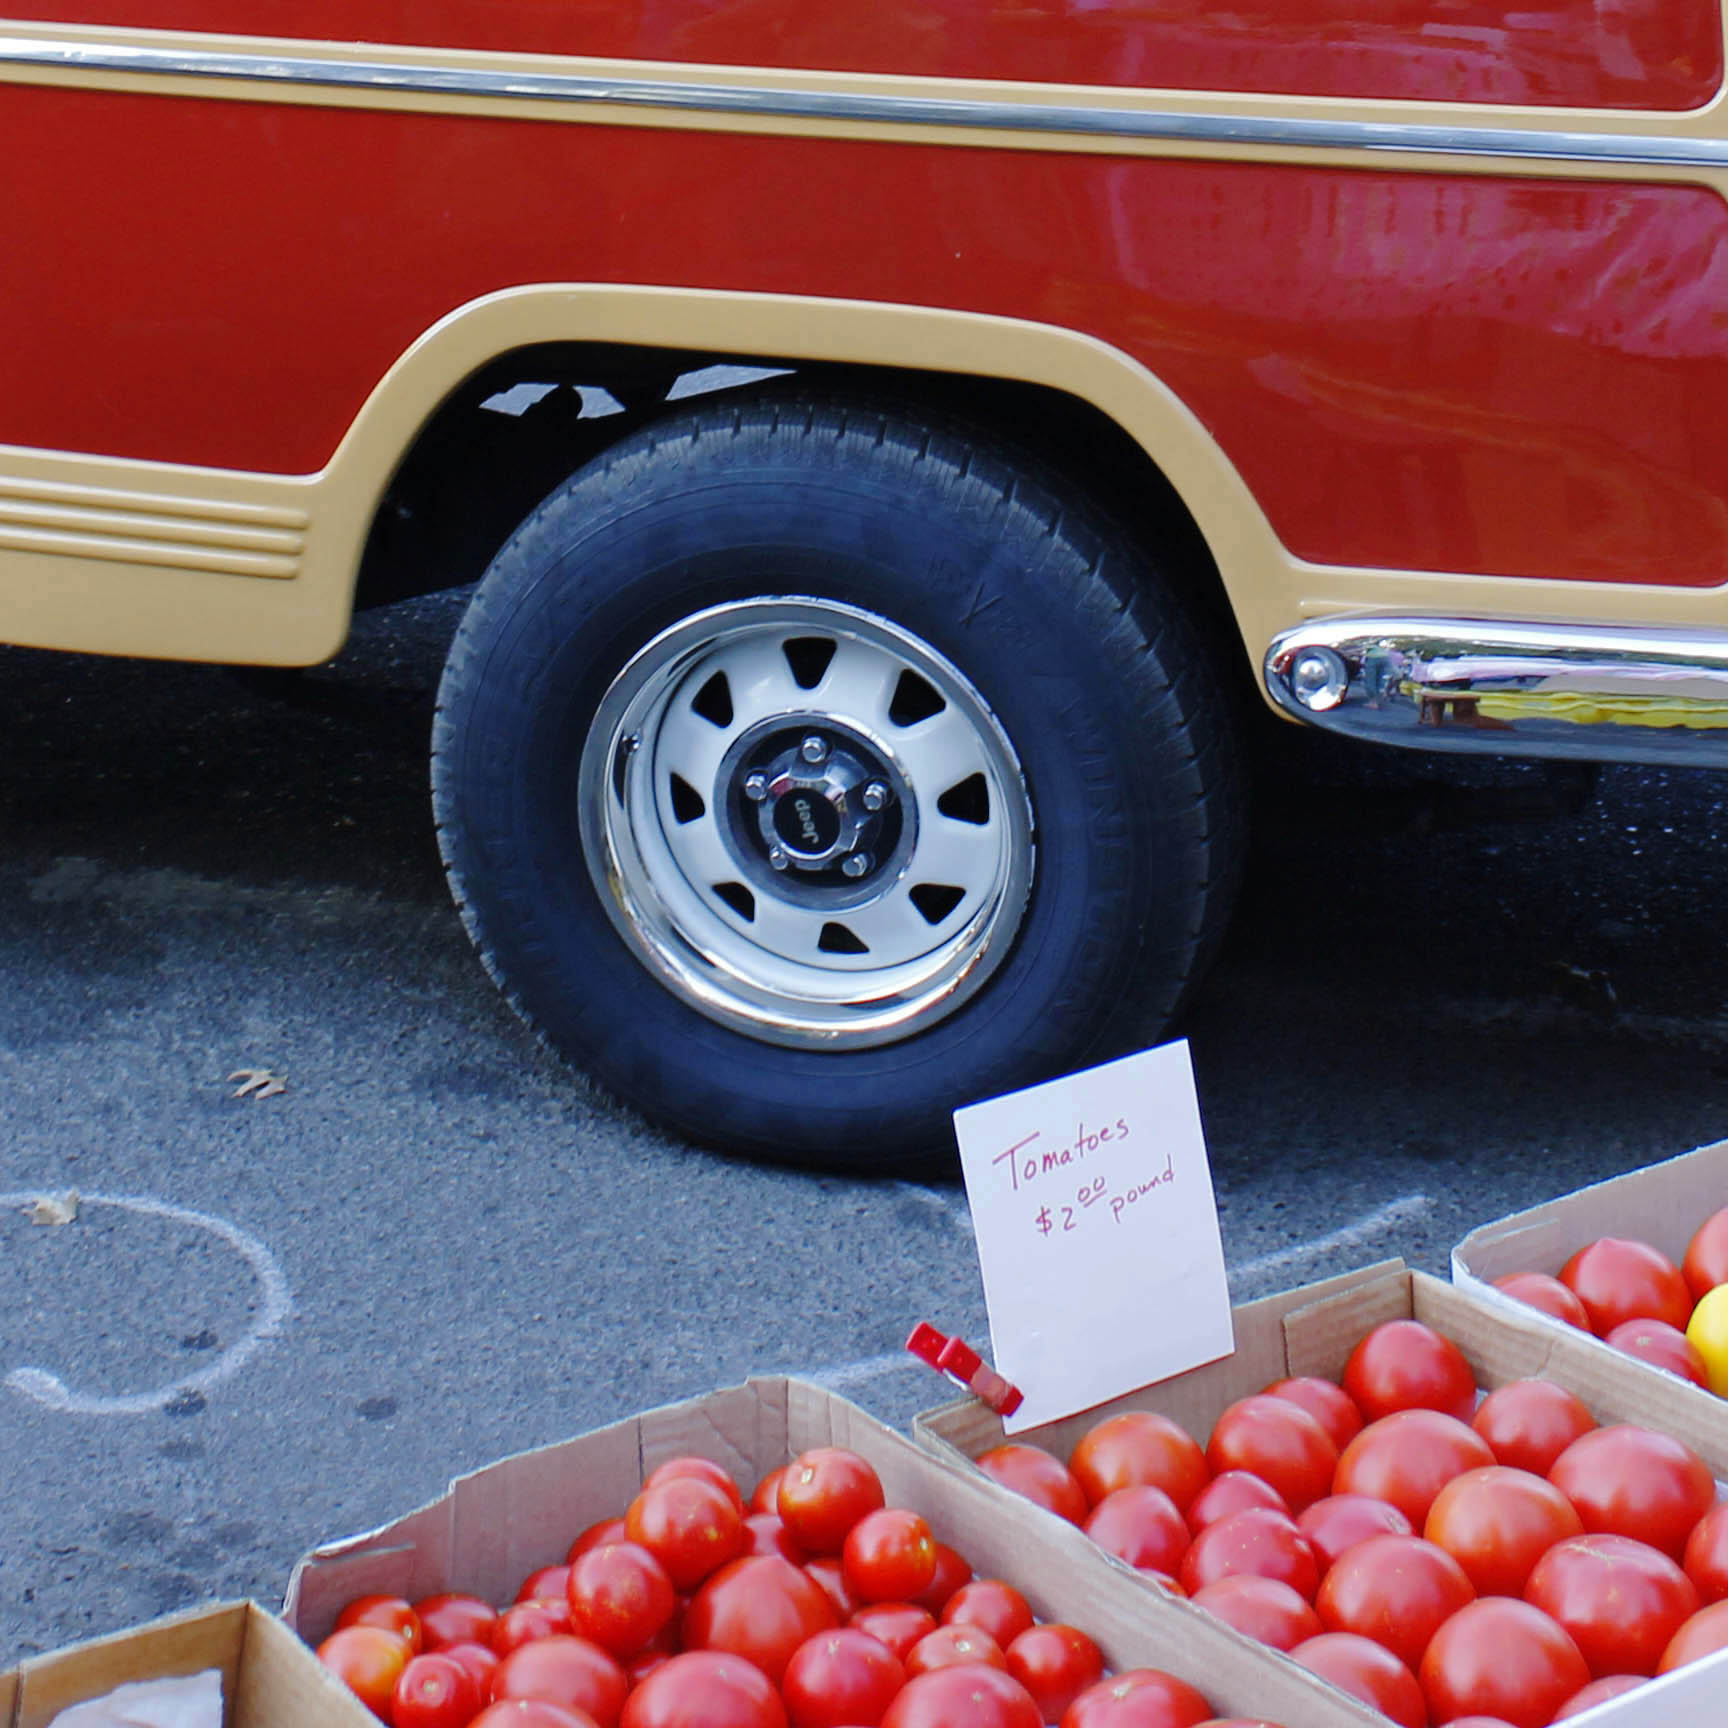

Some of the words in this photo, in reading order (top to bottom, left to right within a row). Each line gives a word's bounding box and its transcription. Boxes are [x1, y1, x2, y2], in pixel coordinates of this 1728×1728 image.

[794, 799, 820, 844] Jeep
[992, 1118, 1130, 1192] Tomatoes
[1109, 1153, 1175, 1224] pound
